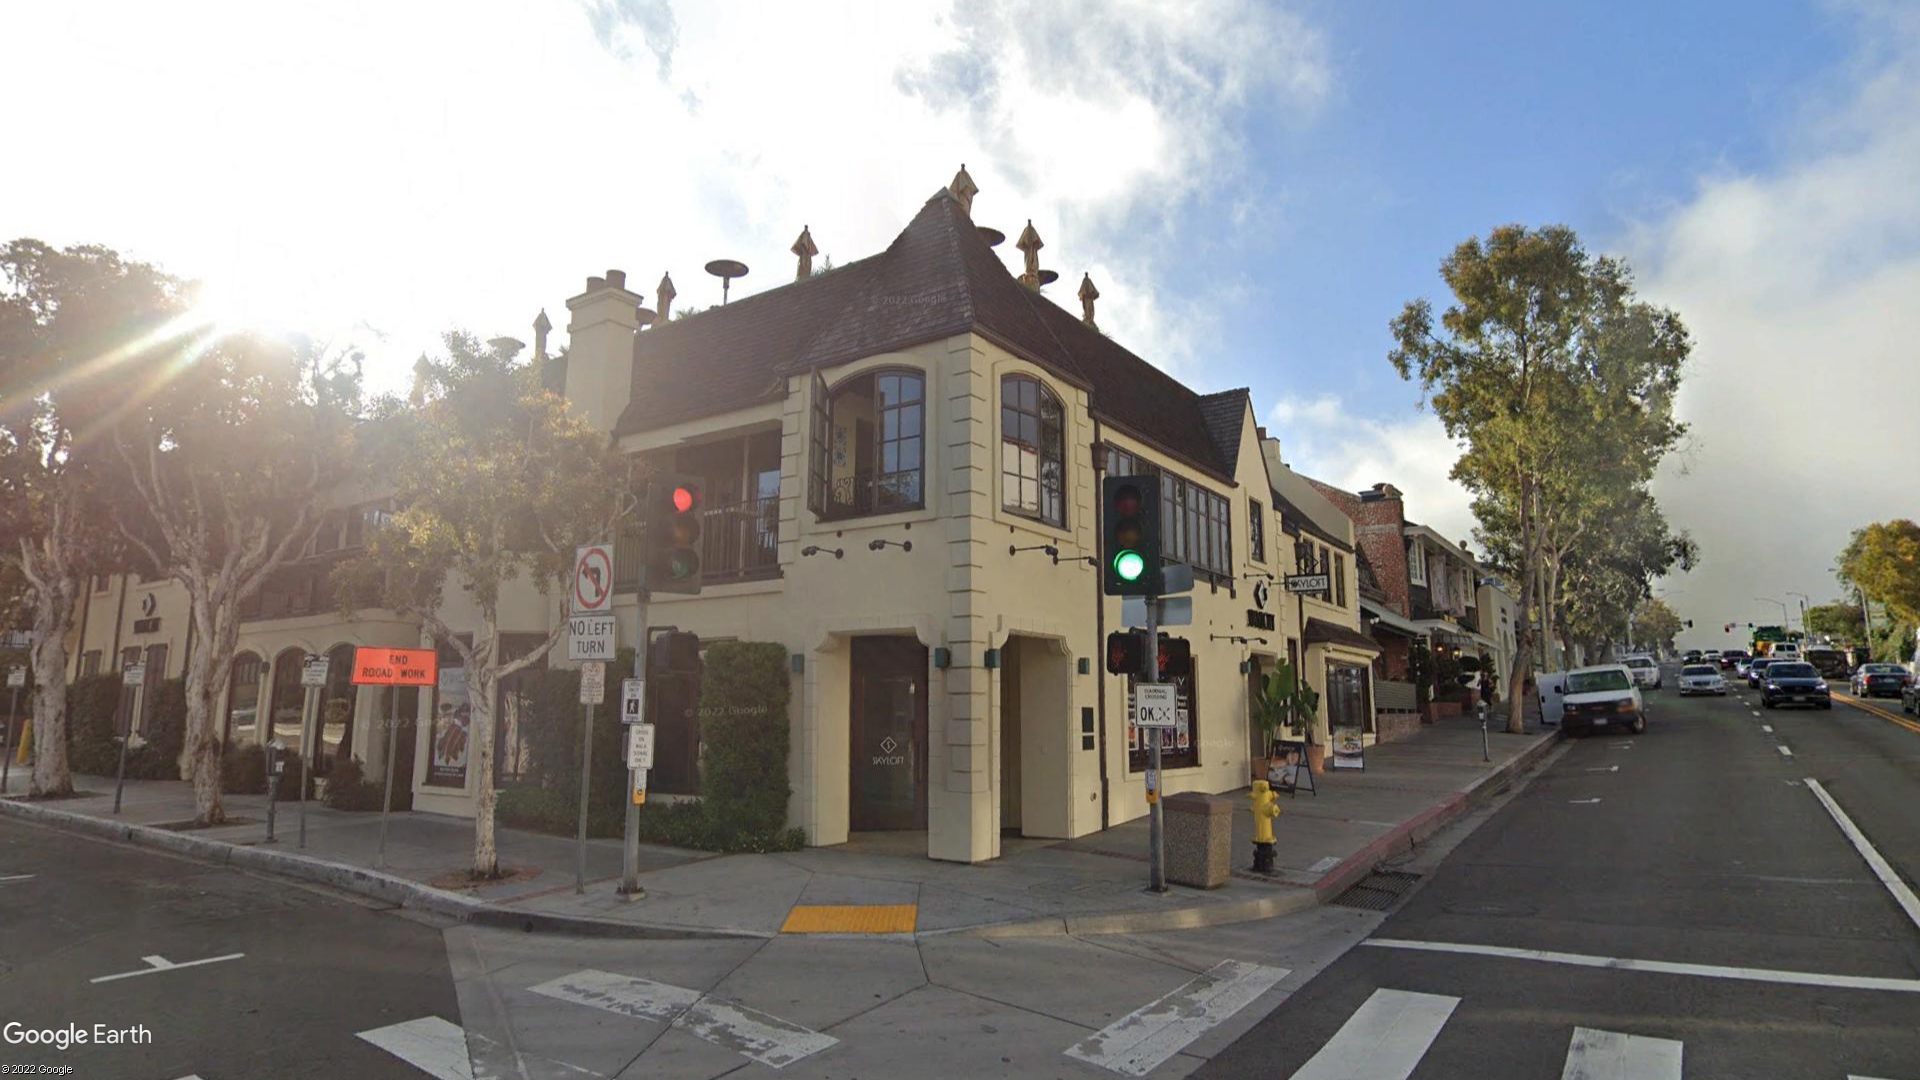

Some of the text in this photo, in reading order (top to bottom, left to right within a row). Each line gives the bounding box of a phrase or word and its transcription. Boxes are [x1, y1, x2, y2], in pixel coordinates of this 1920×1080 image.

[1290, 578, 1326, 589] KYLOFT
[569, 620, 615, 636] NO LEFT
[576, 640, 605, 654] TURN
[389, 655, 409, 665] END
[400, 669, 426, 678] WORK
[1140, 706, 1155, 721] OK
[872, 756, 904, 765] SKYLOFT
